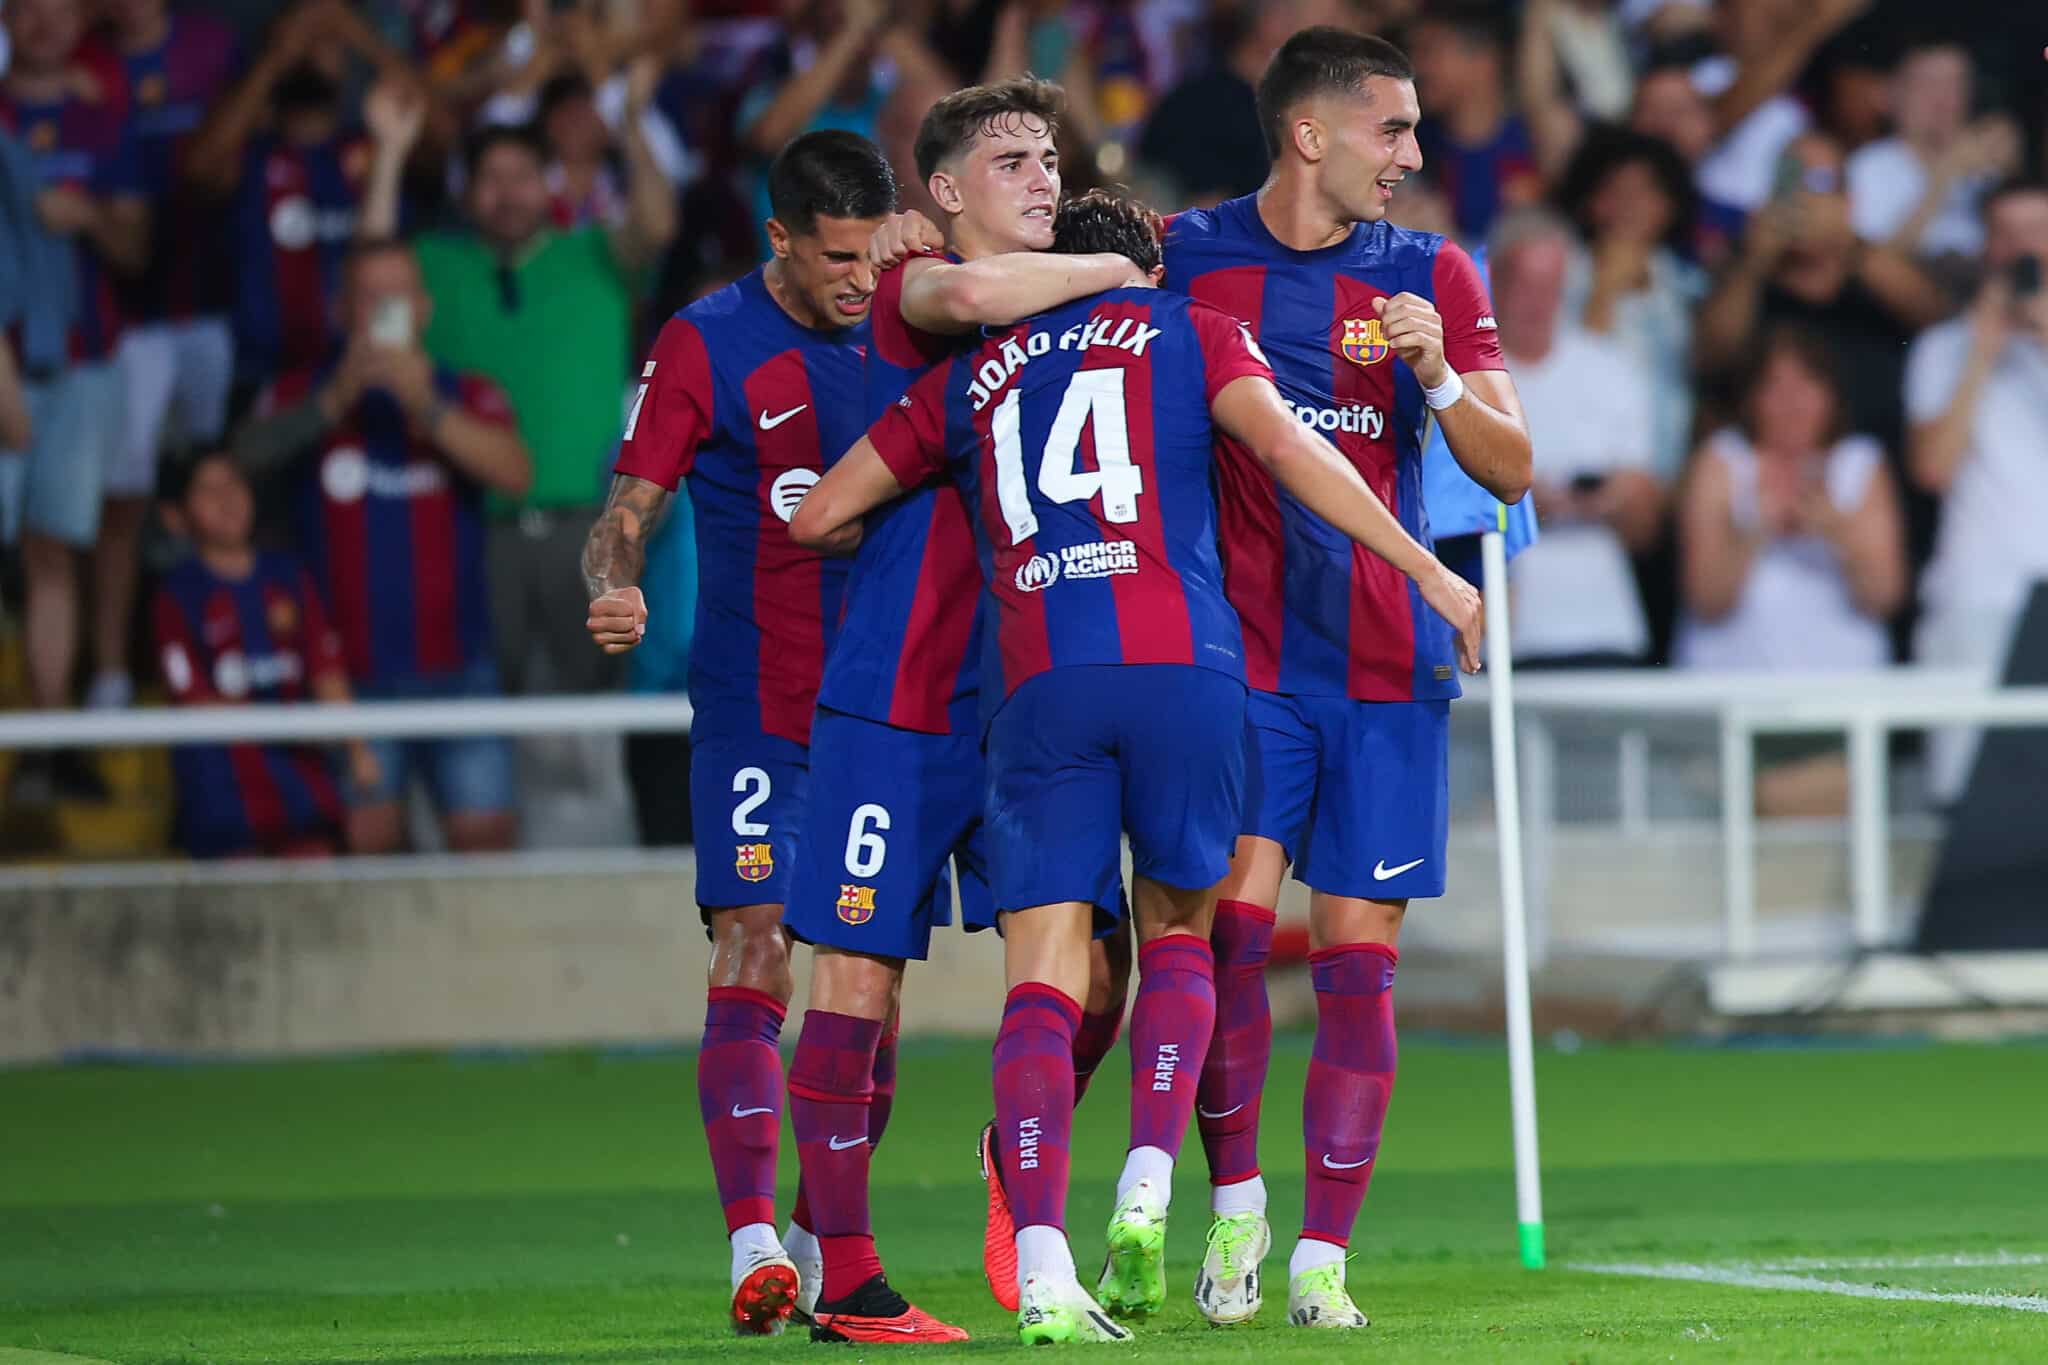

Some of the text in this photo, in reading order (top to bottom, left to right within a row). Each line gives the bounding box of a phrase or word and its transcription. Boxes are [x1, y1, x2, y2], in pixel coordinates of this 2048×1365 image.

[966, 331, 1050, 412] JOÃO
[991, 367, 1143, 546] 14
[1061, 540, 1137, 561] UNHCR
[1063, 554, 1138, 574] ACNUR
[732, 766, 771, 836] 2
[844, 803, 891, 878] 6
[1152, 1043, 1180, 1092] BARÇA
[1020, 1116, 1041, 1170] BARÇA
